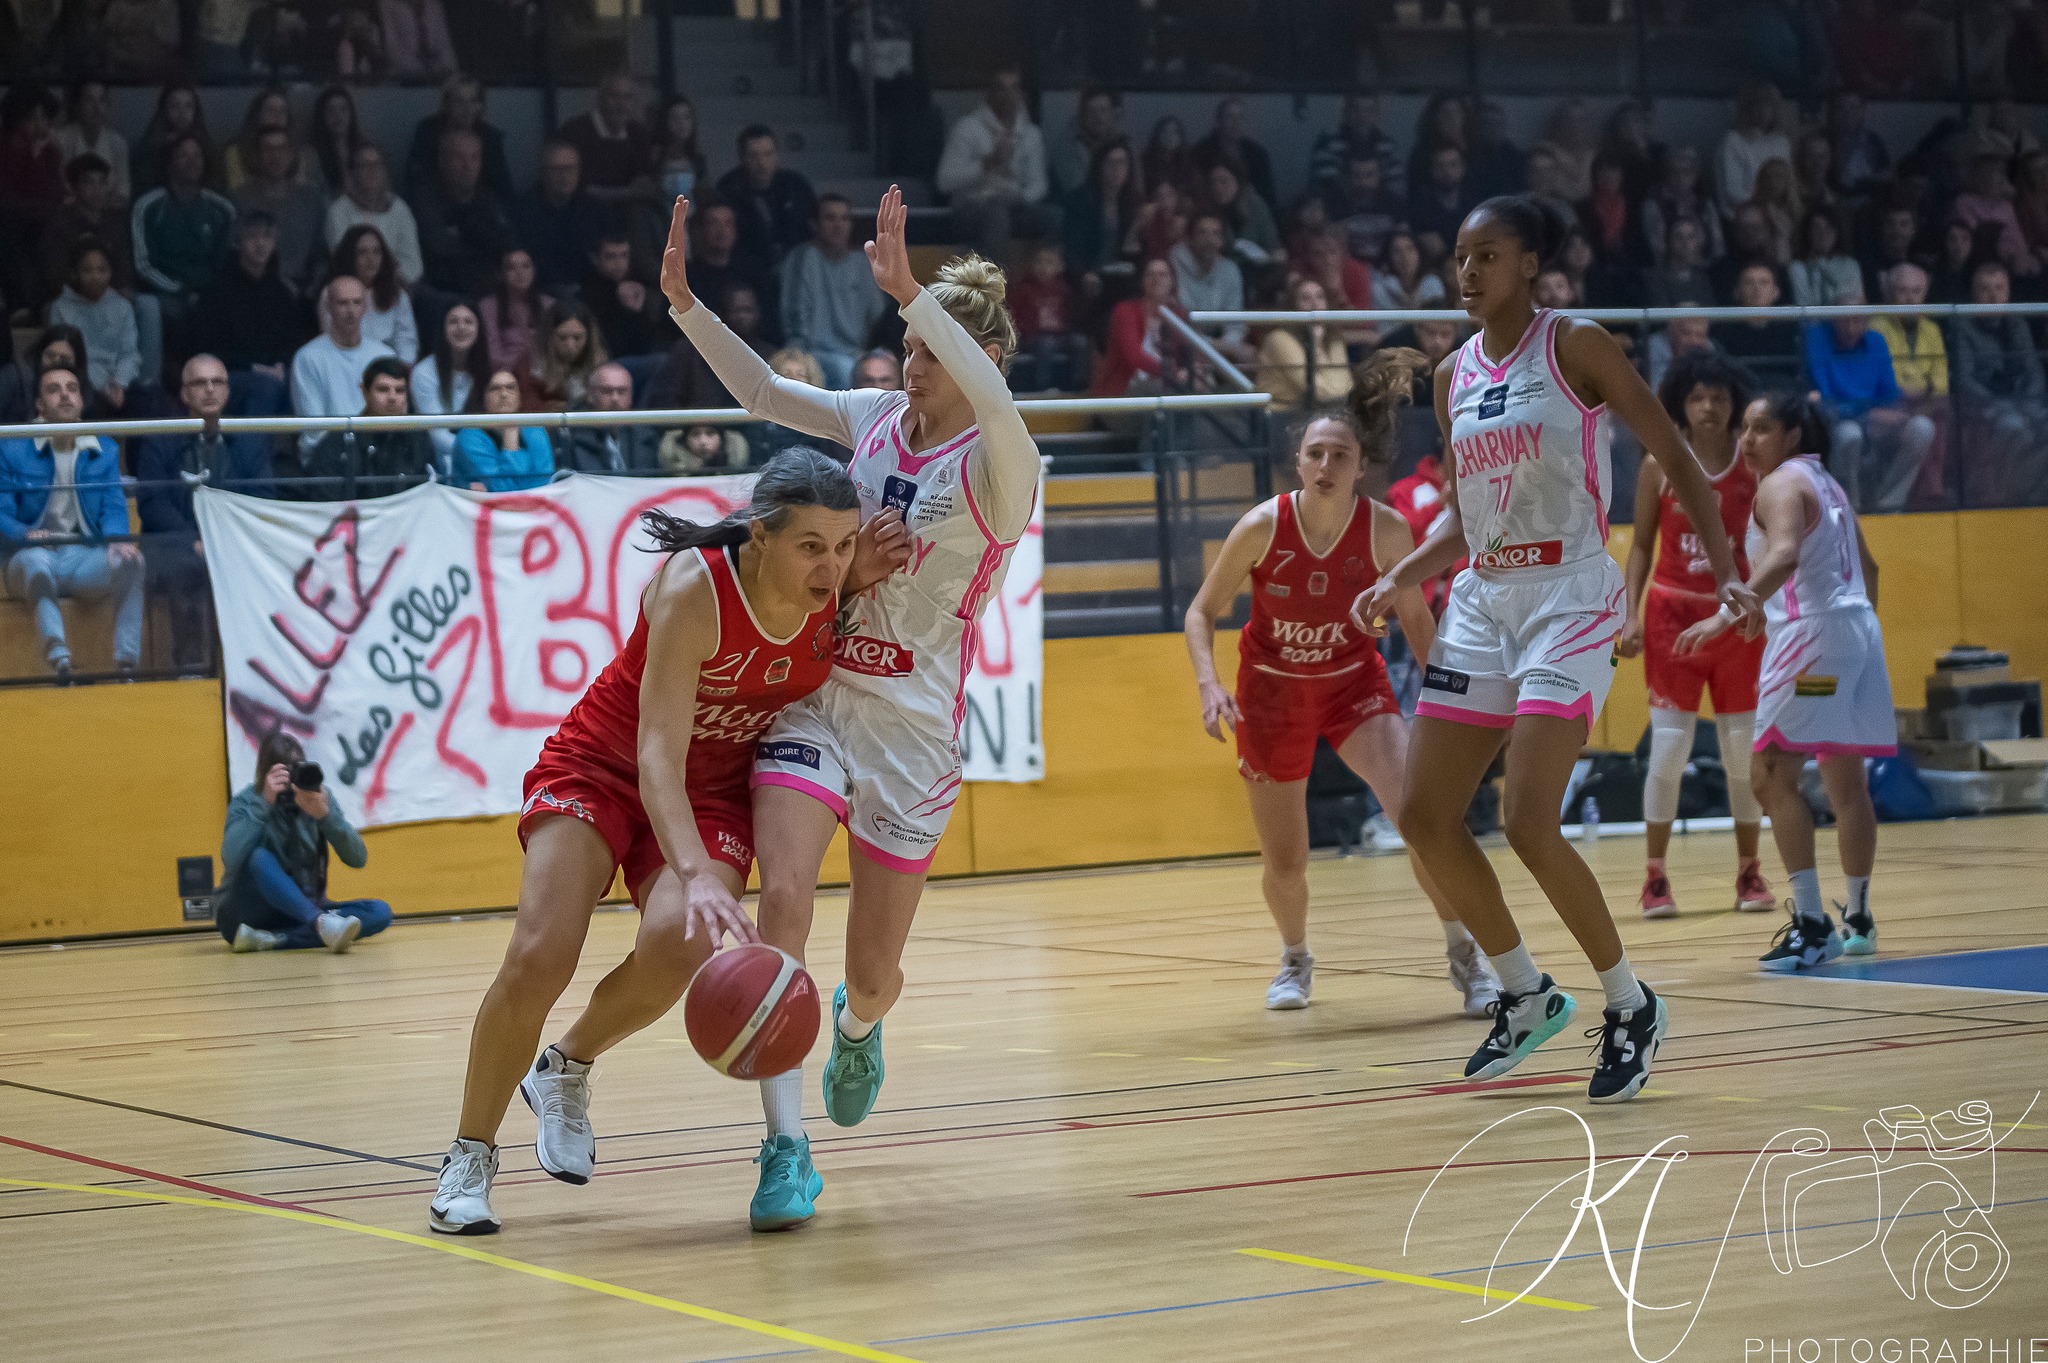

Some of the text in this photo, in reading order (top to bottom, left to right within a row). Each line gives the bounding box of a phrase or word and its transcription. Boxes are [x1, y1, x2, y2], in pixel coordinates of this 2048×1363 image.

[1453, 421, 1544, 479] CHARNAY
[1488, 473, 1513, 516] 77
[1272, 550, 1296, 575] 7
[700, 646, 761, 682] 21
[1428, 671, 1450, 683] LOIRE
[774, 747, 800, 757] LOIRE
